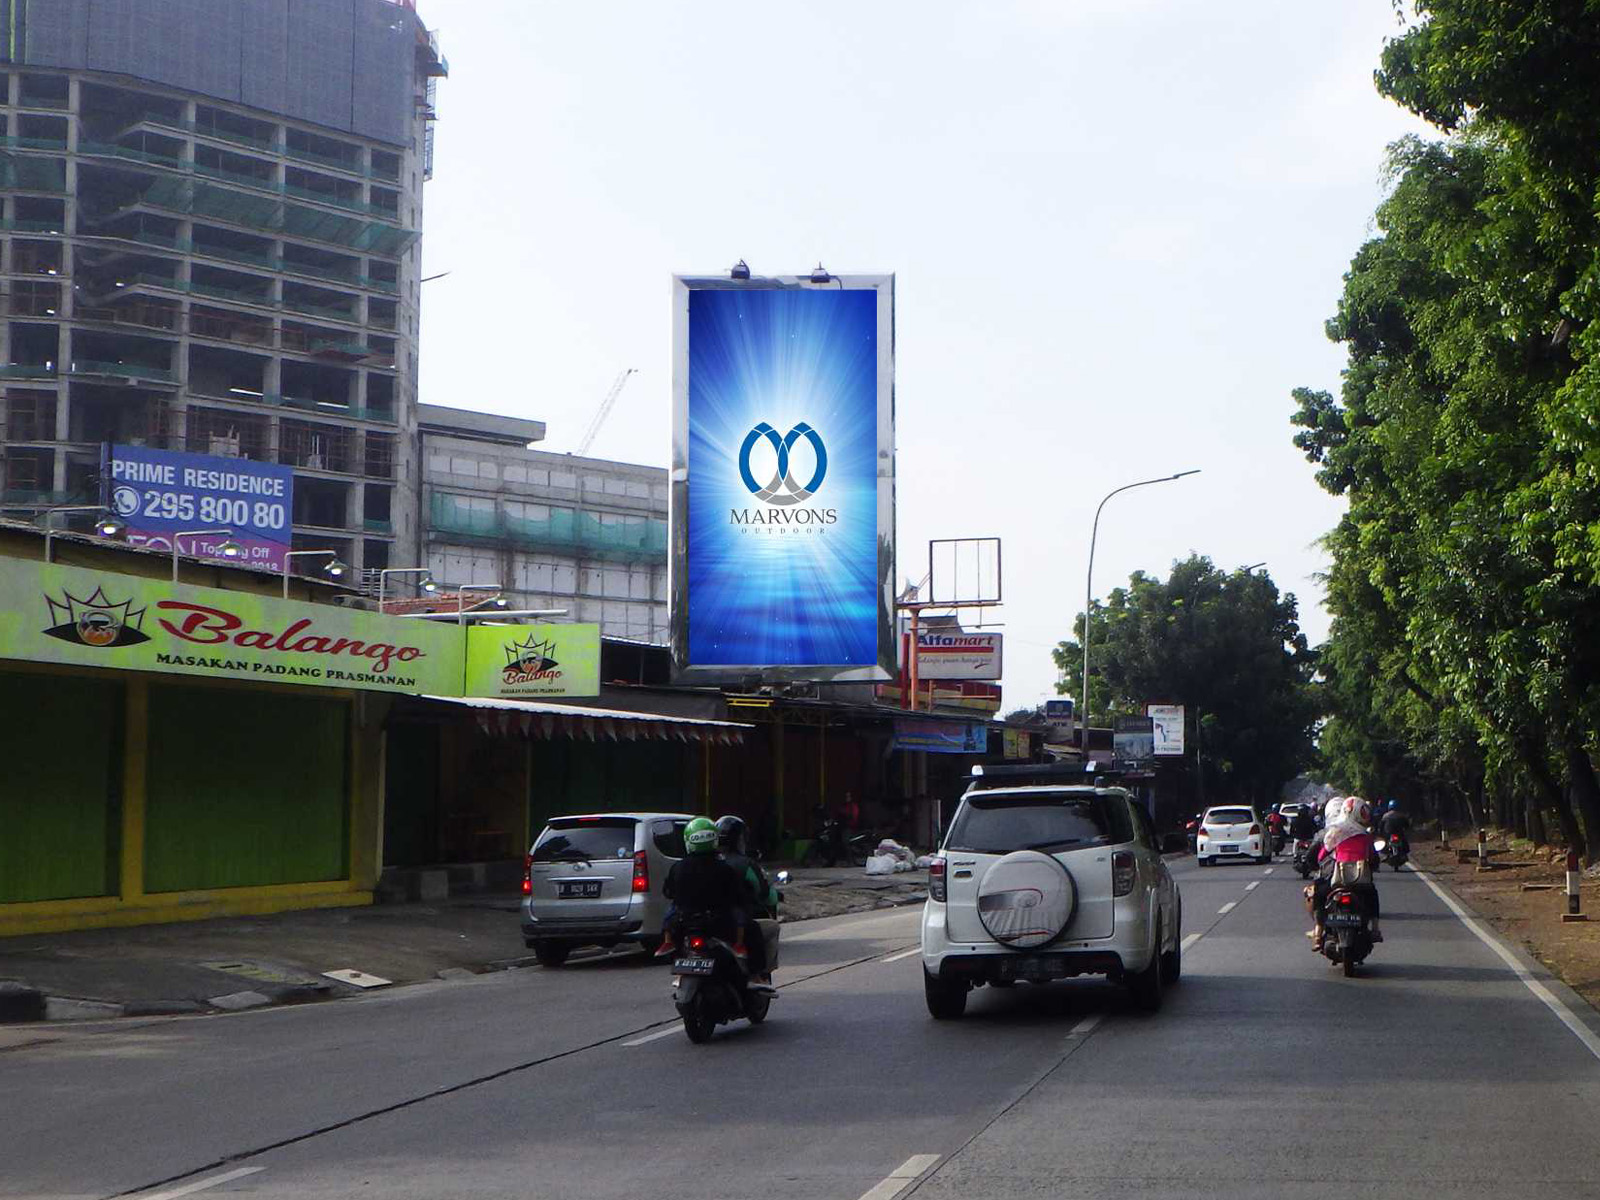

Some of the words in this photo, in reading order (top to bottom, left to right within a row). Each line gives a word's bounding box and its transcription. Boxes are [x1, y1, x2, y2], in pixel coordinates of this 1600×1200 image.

[112, 460, 175, 485] PRIME
[184, 468, 284, 497] RESIDENCE
[144, 491, 195, 521] 295
[200, 496, 249, 526] 800
[253, 502, 285, 529] 80
[729, 508, 838, 524] MARVONS
[252, 546, 270, 558] Off
[157, 600, 426, 672] Balango
[917, 633, 993, 646] Alfamart
[156, 653, 248, 671] MASAKAN
[252, 663, 321, 678] PADANG
[326, 669, 416, 687] PRASMANAN
[503, 667, 562, 685] Balango
